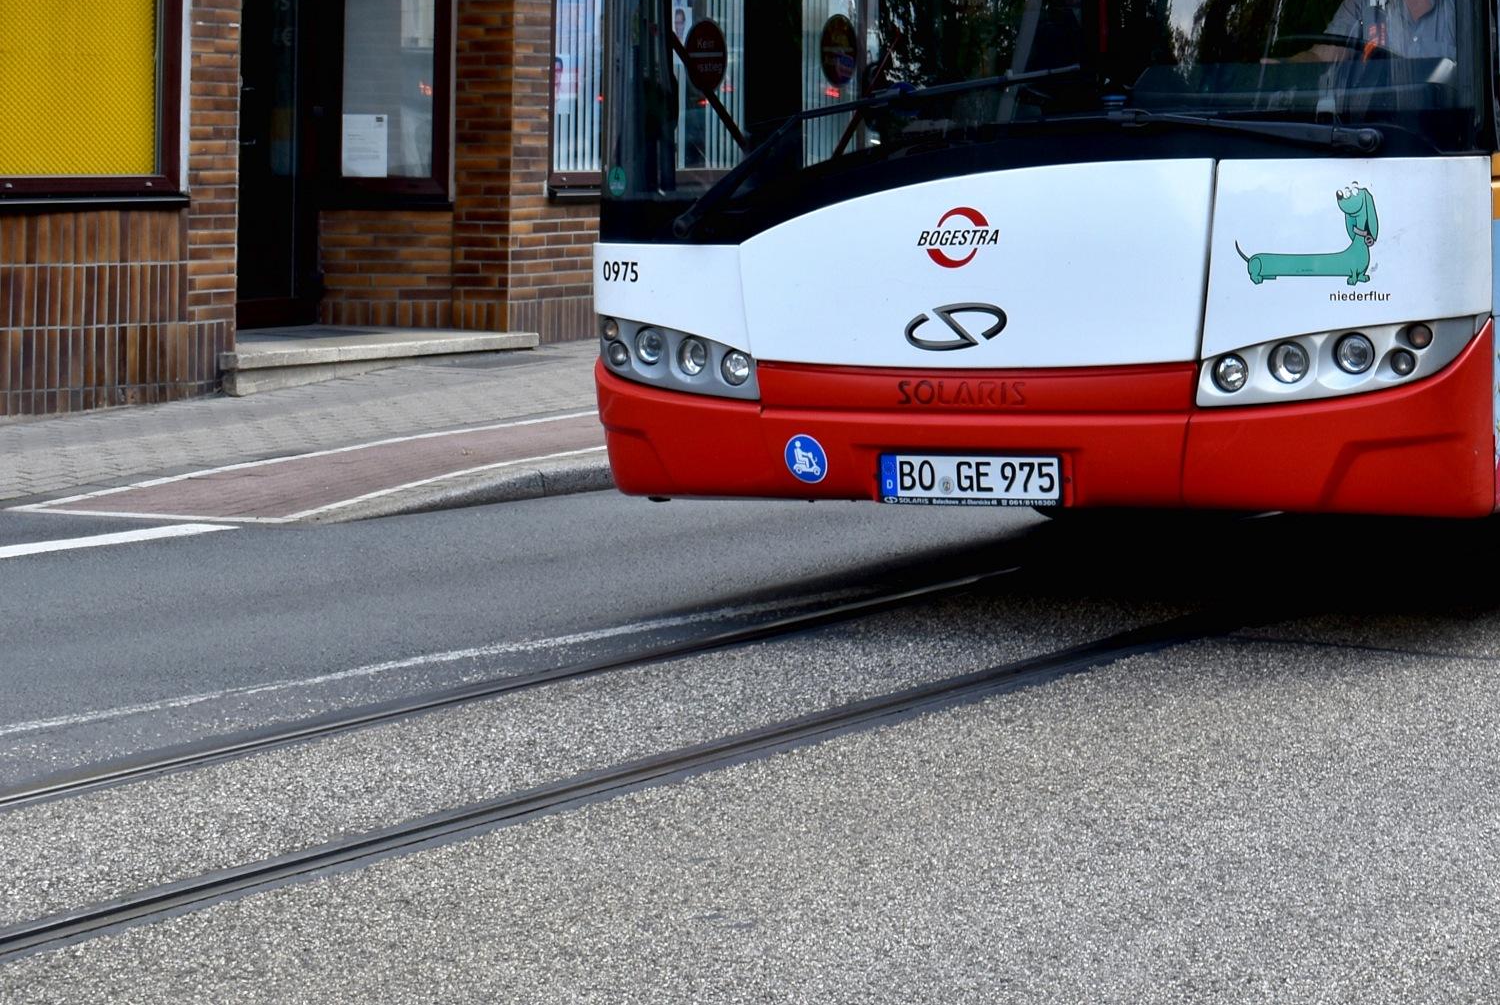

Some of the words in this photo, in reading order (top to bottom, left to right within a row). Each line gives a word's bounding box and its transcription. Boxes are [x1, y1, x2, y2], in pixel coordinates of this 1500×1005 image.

[917, 229, 1000, 247] BOGESTRA
[602, 260, 639, 283] 0975
[1329, 290, 1391, 302] niederflur
[897, 379, 1027, 407] SOLARIS
[886, 479, 893, 490] D
[898, 459, 936, 492] BO
[956, 461, 994, 493] GE
[1000, 461, 1056, 494] 975
[899, 497, 929, 505] SOLARIS
